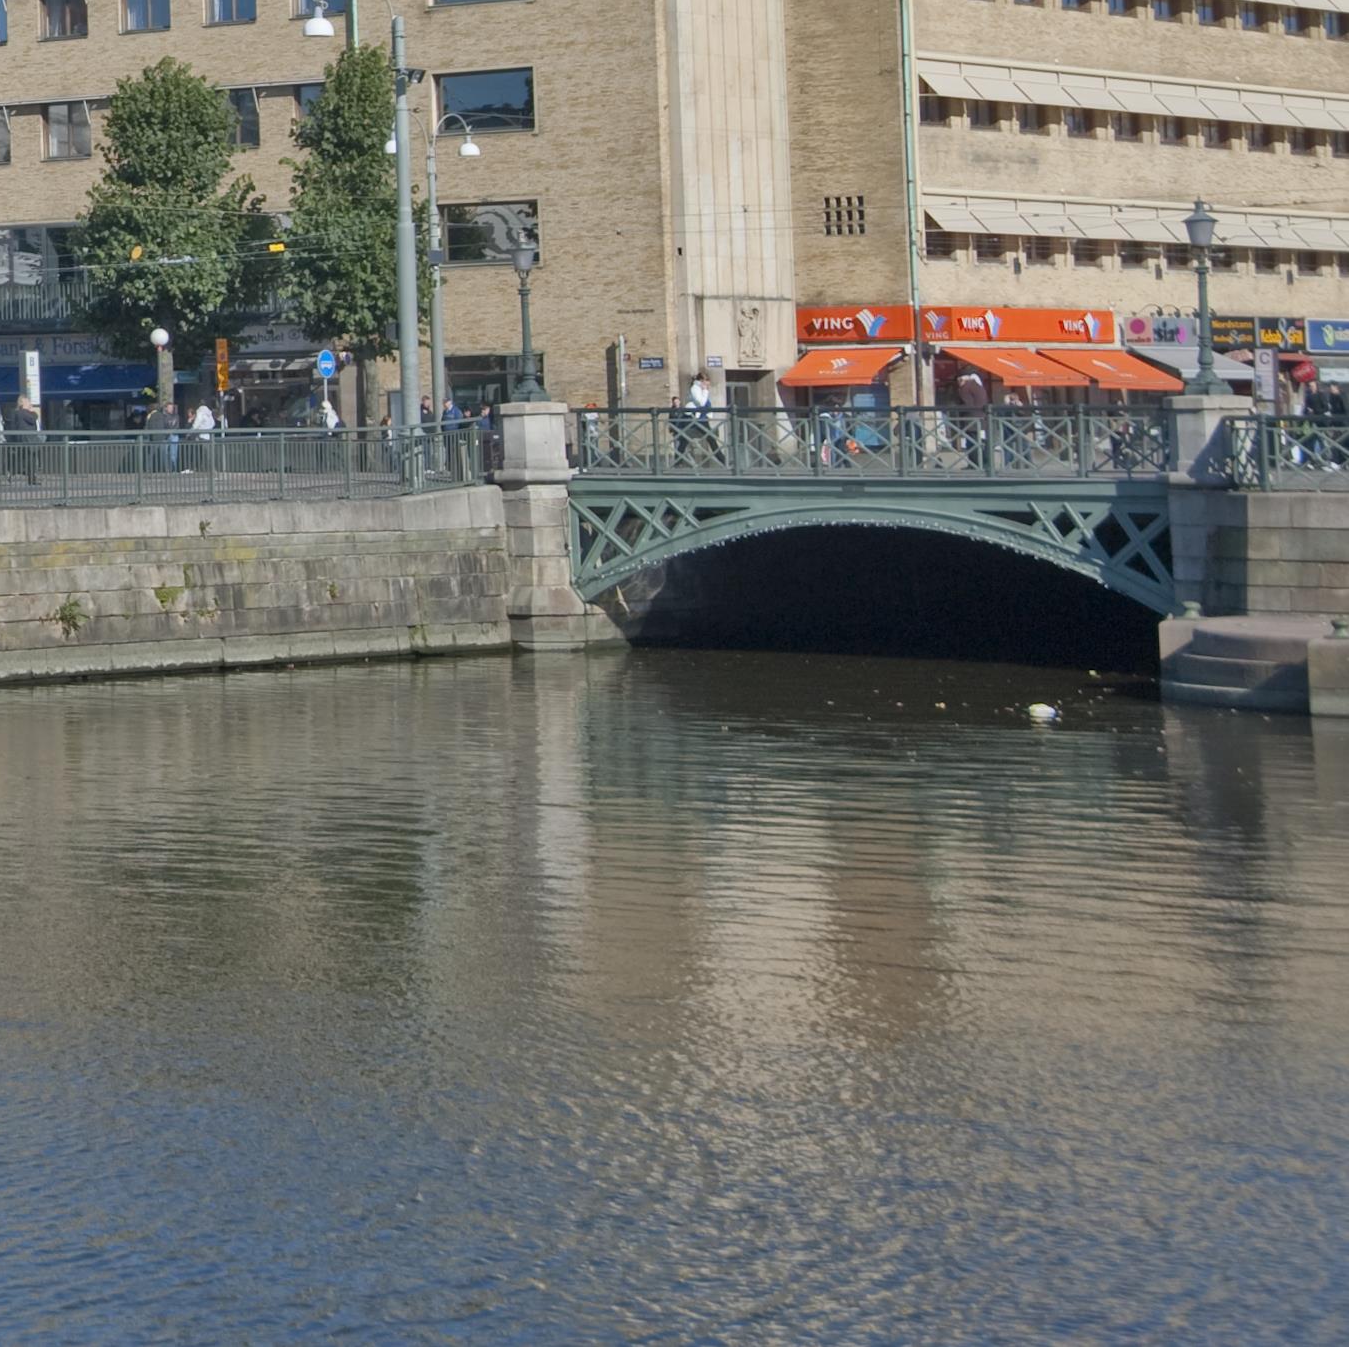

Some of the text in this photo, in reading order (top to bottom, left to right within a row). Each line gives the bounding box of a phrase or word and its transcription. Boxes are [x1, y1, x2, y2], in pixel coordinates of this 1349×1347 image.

[812, 317, 855, 330] VING
[961, 317, 985, 329] VING
[1062, 319, 1086, 333] VING
[925, 332, 950, 340] VING
